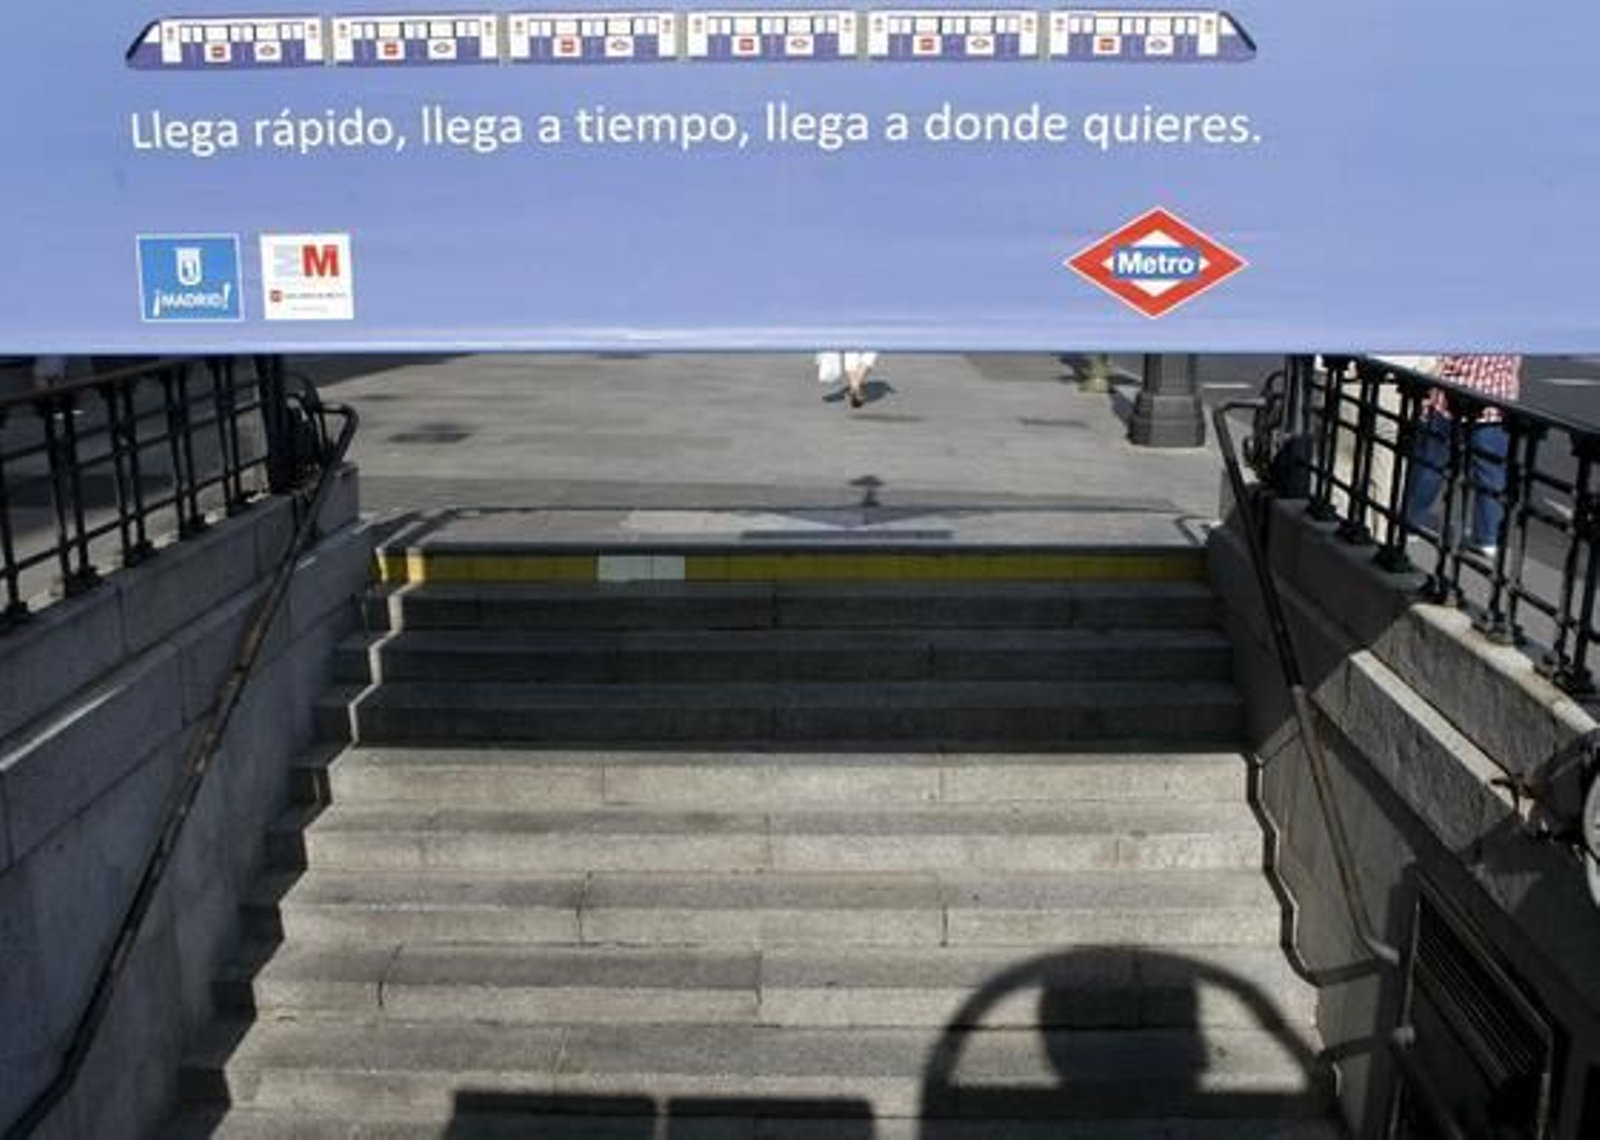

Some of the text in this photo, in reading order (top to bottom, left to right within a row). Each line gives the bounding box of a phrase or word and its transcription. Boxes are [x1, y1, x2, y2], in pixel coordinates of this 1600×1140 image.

[131, 101, 1262, 158] Llega rápido, llega a tiempo, llega a donde quieres.
[1117, 251, 1195, 275] Metro
[152, 283, 231, 317] ¡MADRID!
